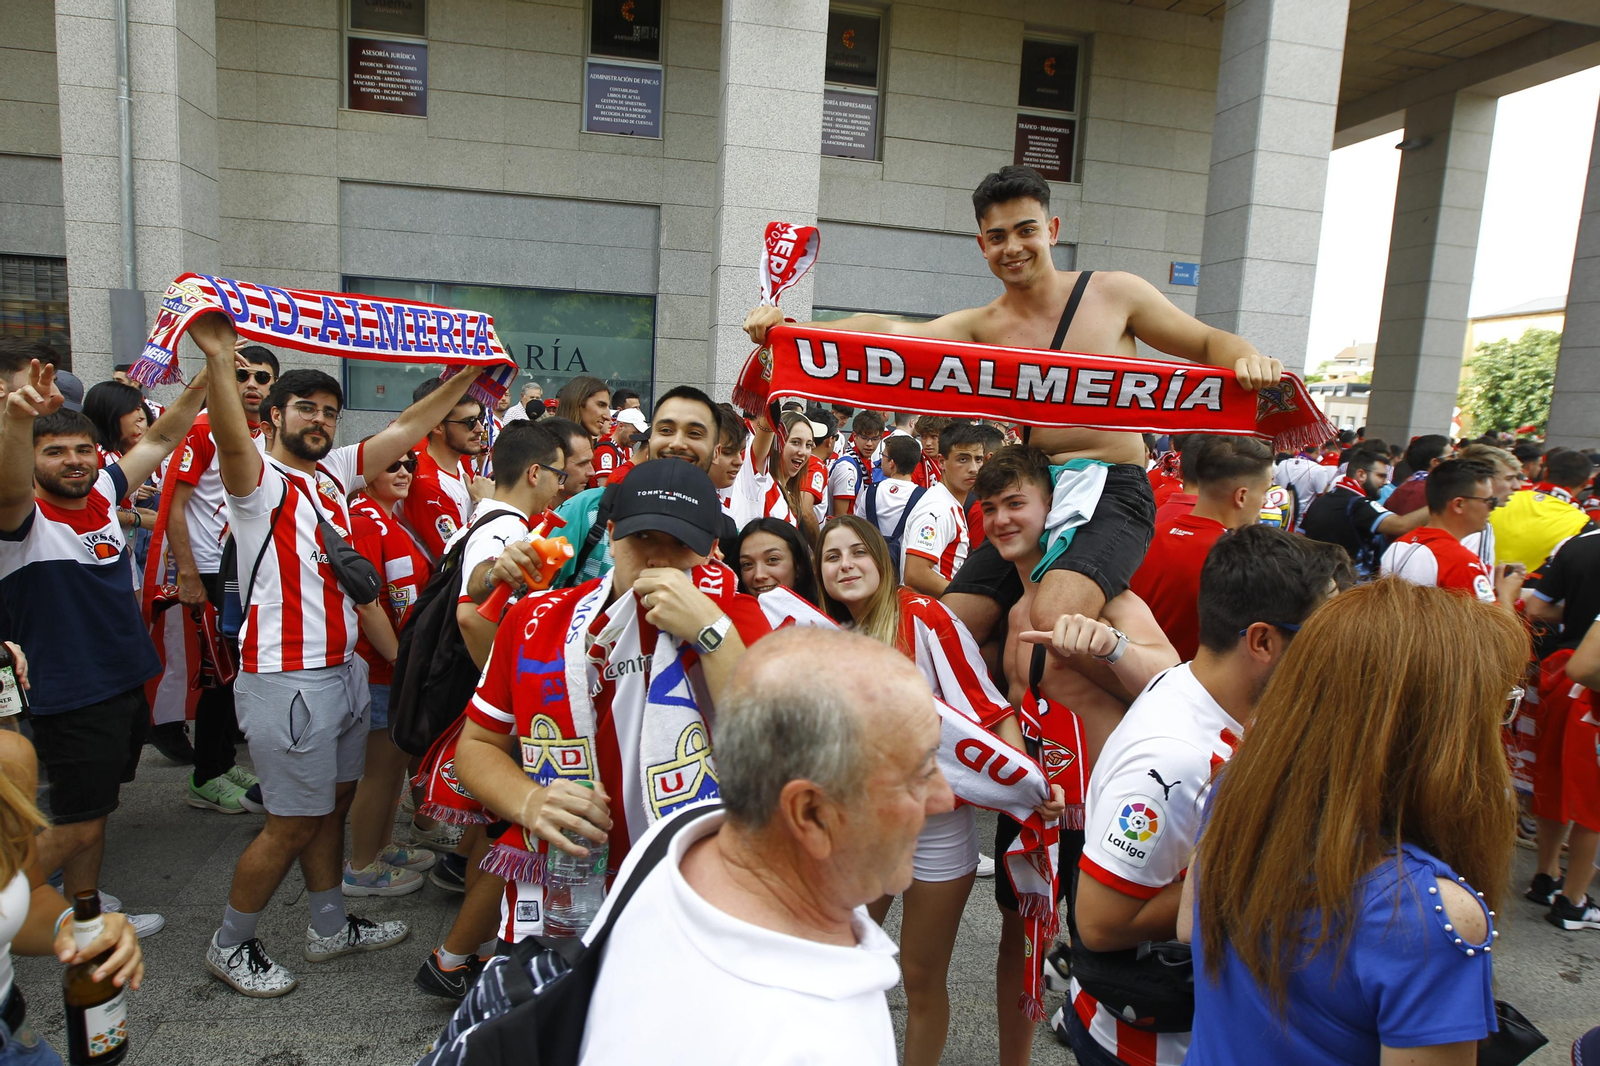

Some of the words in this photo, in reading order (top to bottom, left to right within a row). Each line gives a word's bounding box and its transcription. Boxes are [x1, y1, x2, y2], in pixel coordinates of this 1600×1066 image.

[362, 49, 389, 58] ASESORÍA
[590, 74, 632, 83] ADMINISTRACIÓN
[839, 101, 872, 110] EMPRESARIAL
[142, 345, 173, 365] MERIA
[673, 491, 698, 505] HILFIGER
[561, 750, 581, 766] D
[1108, 833, 1146, 859] LaLiga
